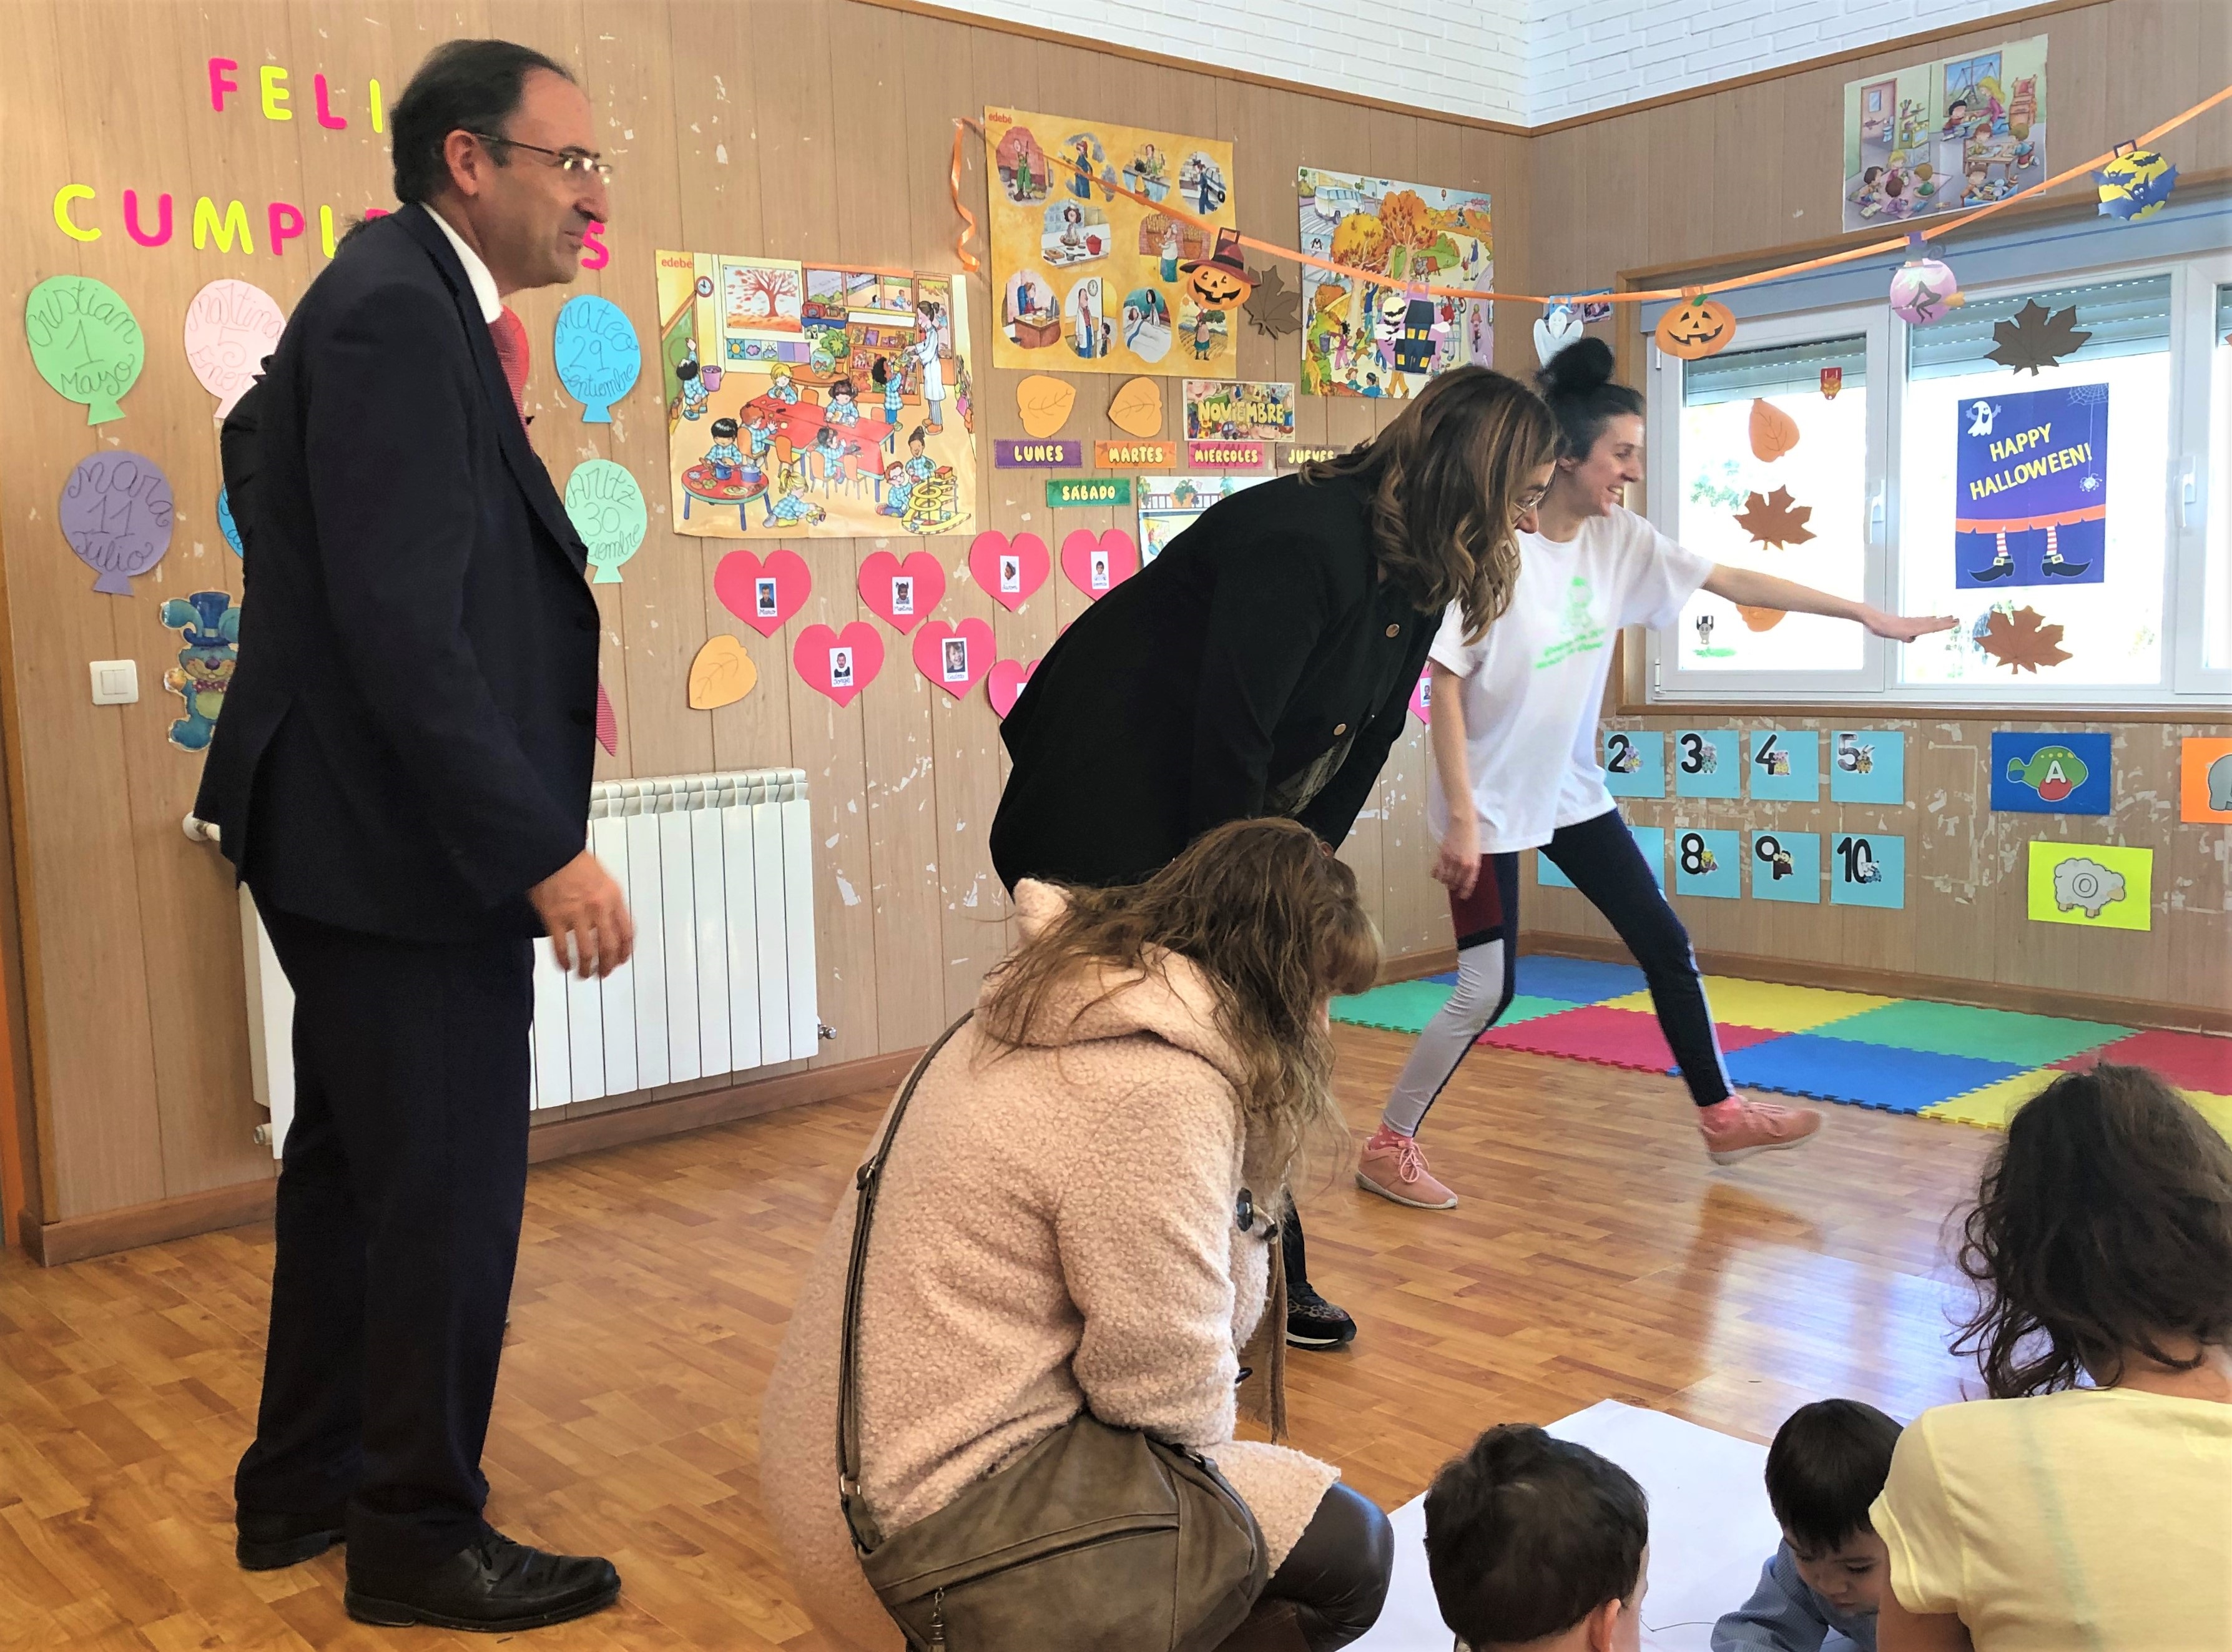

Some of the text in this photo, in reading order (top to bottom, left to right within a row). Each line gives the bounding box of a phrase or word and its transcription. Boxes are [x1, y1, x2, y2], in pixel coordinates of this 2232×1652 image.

[208, 57, 383, 133] FELI
[27, 281, 135, 347] Cristian
[66, 319, 104, 369] 1
[217, 326, 247, 367] 5
[569, 336, 610, 372] 29
[61, 353, 135, 395] Mayo
[190, 345, 255, 391] Ener
[1014, 445, 1064, 463] LUNES
[1109, 446, 1164, 463] MARTES
[1194, 448, 1258, 463] MIÉRCOLES
[1990, 423, 2052, 461] HAPPY
[1970, 442, 2092, 500] HALLOWEEN!
[1062, 485, 1116, 501] SÁBADO
[86, 494, 135, 539] 11
[584, 502, 621, 536] 30
[72, 530, 154, 572] Julio
[1608, 734, 1630, 774] 2
[1681, 734, 1703, 774] 3
[1754, 734, 1777, 775] 4
[1837, 734, 1860, 772] 5
[2045, 760, 2067, 784] A
[1681, 833, 1705, 875] 8
[1755, 835, 1781, 880] 9
[1836, 837, 1872, 884] 10
[2072, 872, 2098, 898] O
